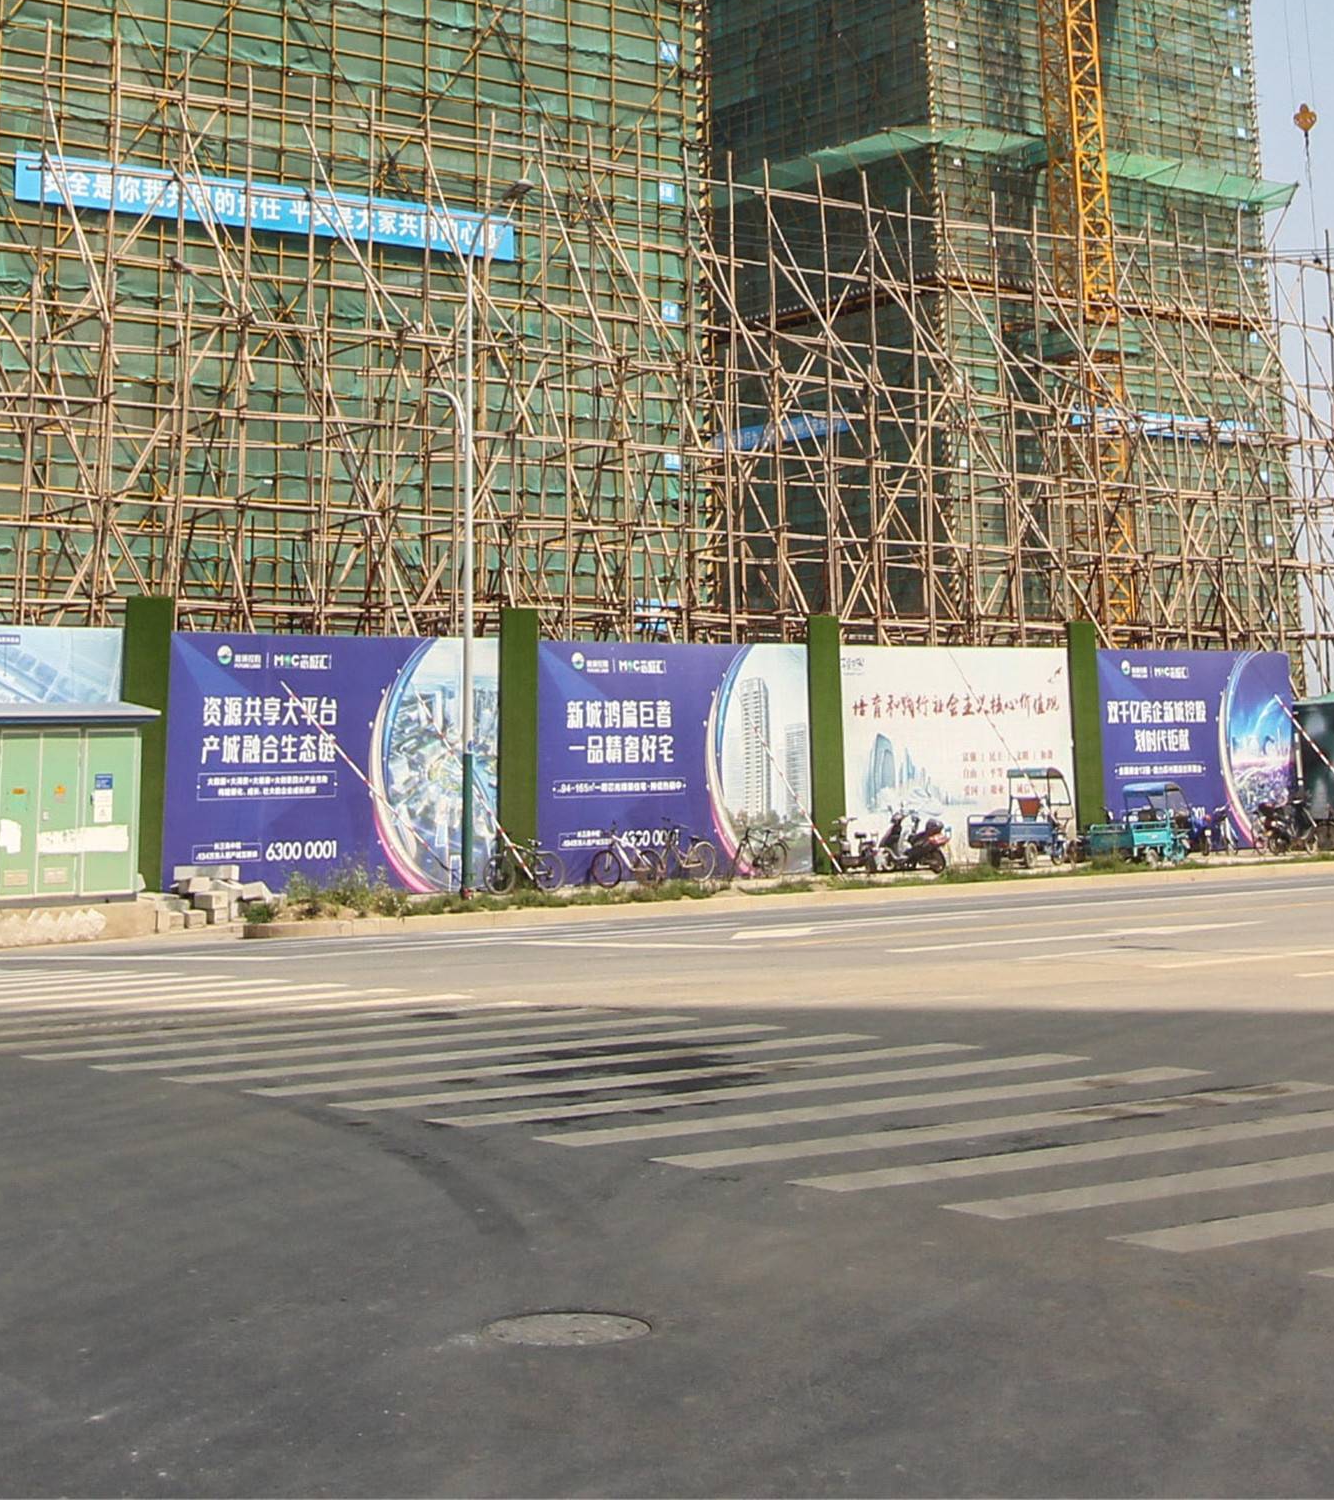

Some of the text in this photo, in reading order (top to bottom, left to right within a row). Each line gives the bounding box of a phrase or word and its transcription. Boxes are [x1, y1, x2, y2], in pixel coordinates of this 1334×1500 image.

[203, 697, 337, 726] 资源共享大平台
[567, 700, 671, 729] 新城鸿篇巨著
[1107, 700, 1207, 724] 双千亿房企新城控股
[201, 734, 336, 764] 产城融合生态链
[569, 735, 674, 763] 一品精奢好宅
[266, 842, 301, 861] 6300
[305, 840, 337, 859] 0001
